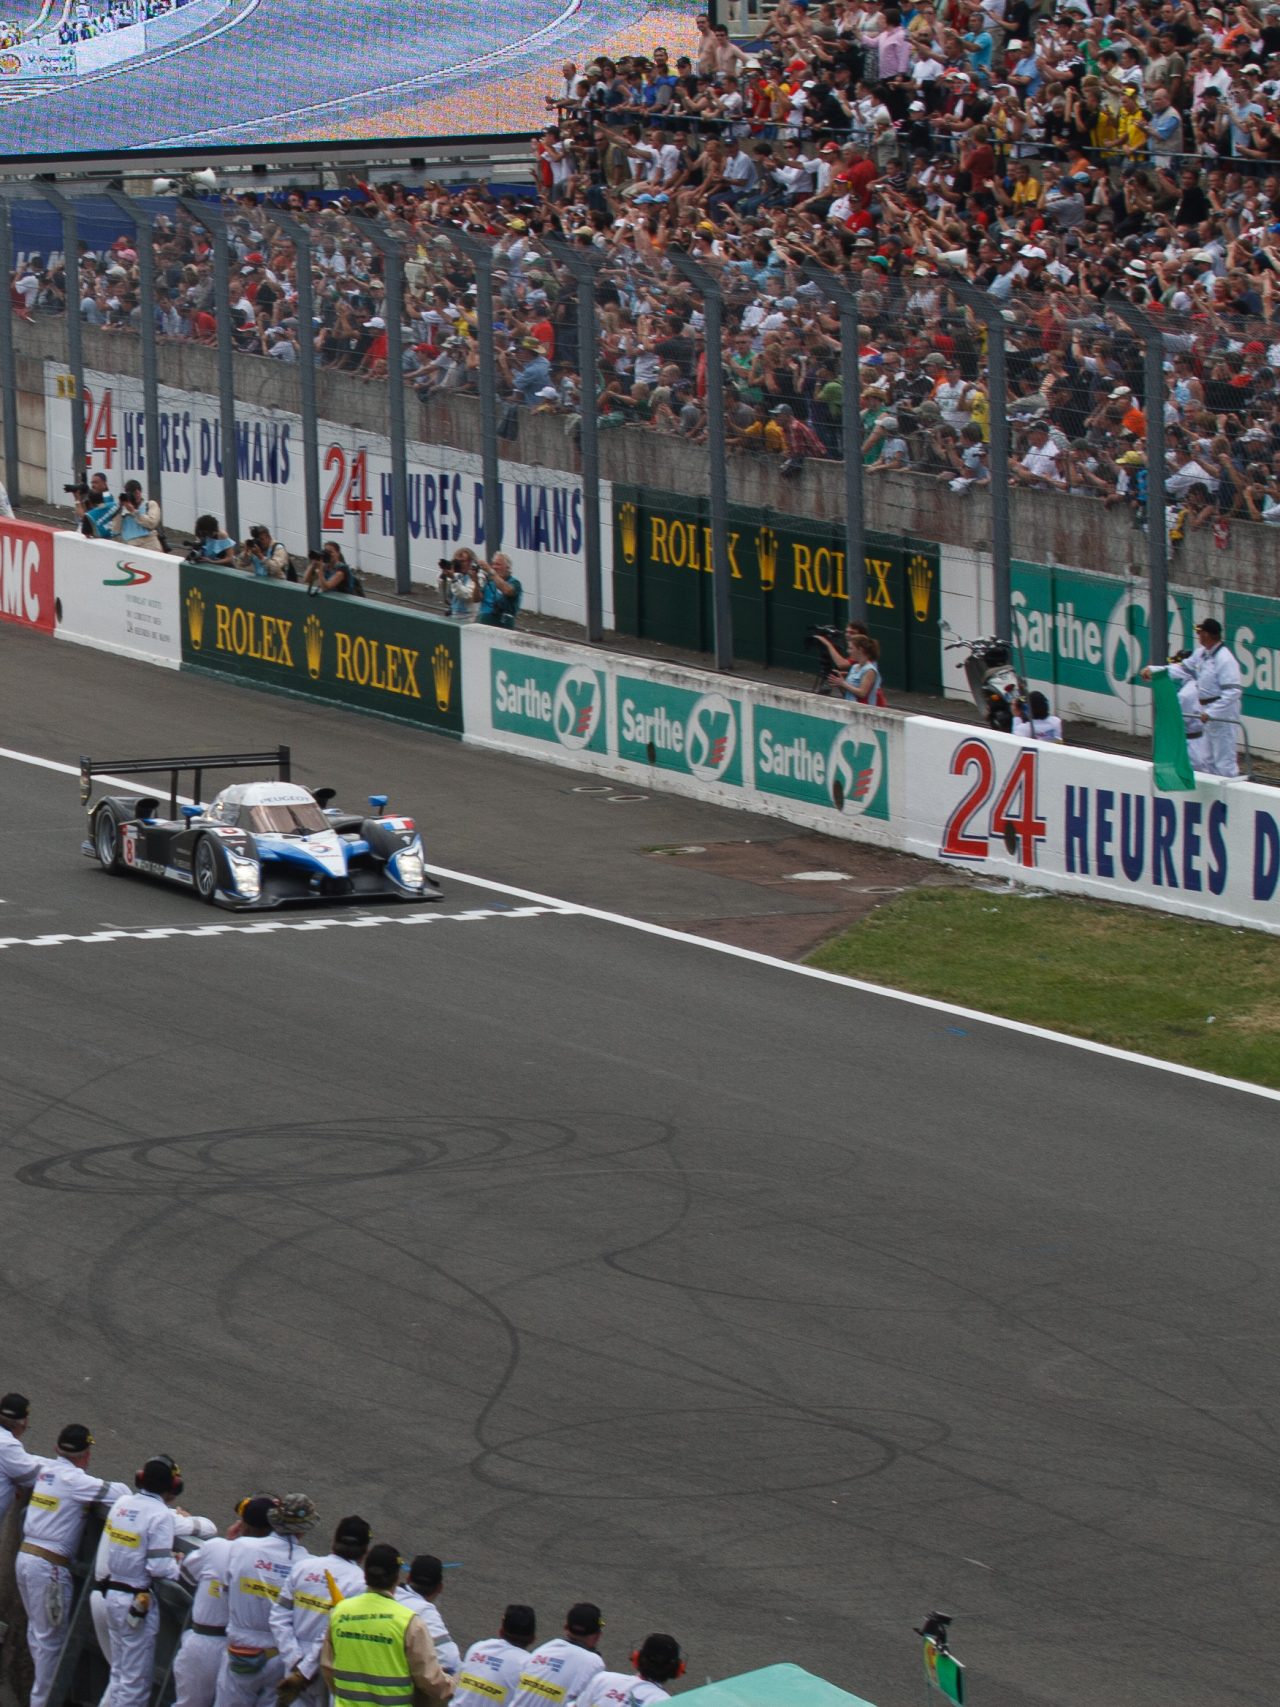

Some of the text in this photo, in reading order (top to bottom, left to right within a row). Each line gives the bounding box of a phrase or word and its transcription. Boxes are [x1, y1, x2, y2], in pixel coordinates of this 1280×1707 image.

[124, 411, 191, 474] HERES
[236, 420, 290, 485] MANS
[320, 442, 373, 535] 24
[381, 473, 462, 542] HURES
[515, 484, 582, 555] MANS
[215, 604, 421, 698] ROLEX ROLEX
[1011, 591, 1103, 665] Sarthe
[495, 670, 552, 718] Sarthe
[622, 699, 684, 753] Sarthe
[758, 729, 826, 785] Sarthe
[938, 737, 1047, 869] 24
[1064, 784, 1228, 896] HEURES
[254, 1559, 273, 1571] 24
[304, 1572, 321, 1583] 24
[335, 1628, 393, 1645] Commissaire
[471, 1652, 487, 1664] 24
[532, 1654, 548, 1665] 24
[606, 1688, 626, 1702] 24
